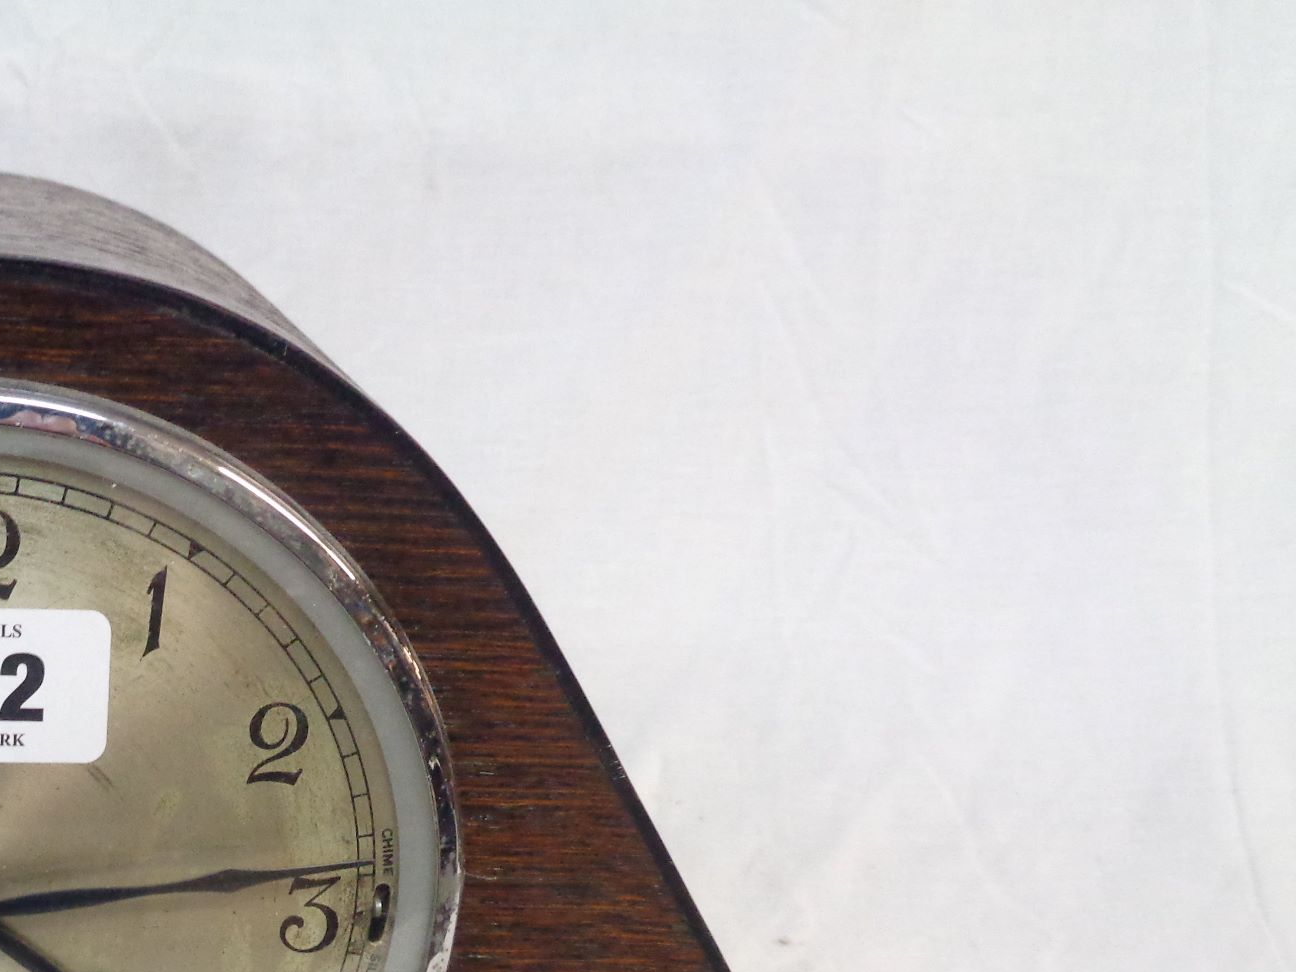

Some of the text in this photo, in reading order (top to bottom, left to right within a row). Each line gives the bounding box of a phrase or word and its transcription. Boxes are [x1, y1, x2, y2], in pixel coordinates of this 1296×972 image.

[140, 565, 168, 662] 1
[246, 702, 309, 786] 2
[381, 828, 394, 877] CHIME
[279, 875, 342, 953] 3
